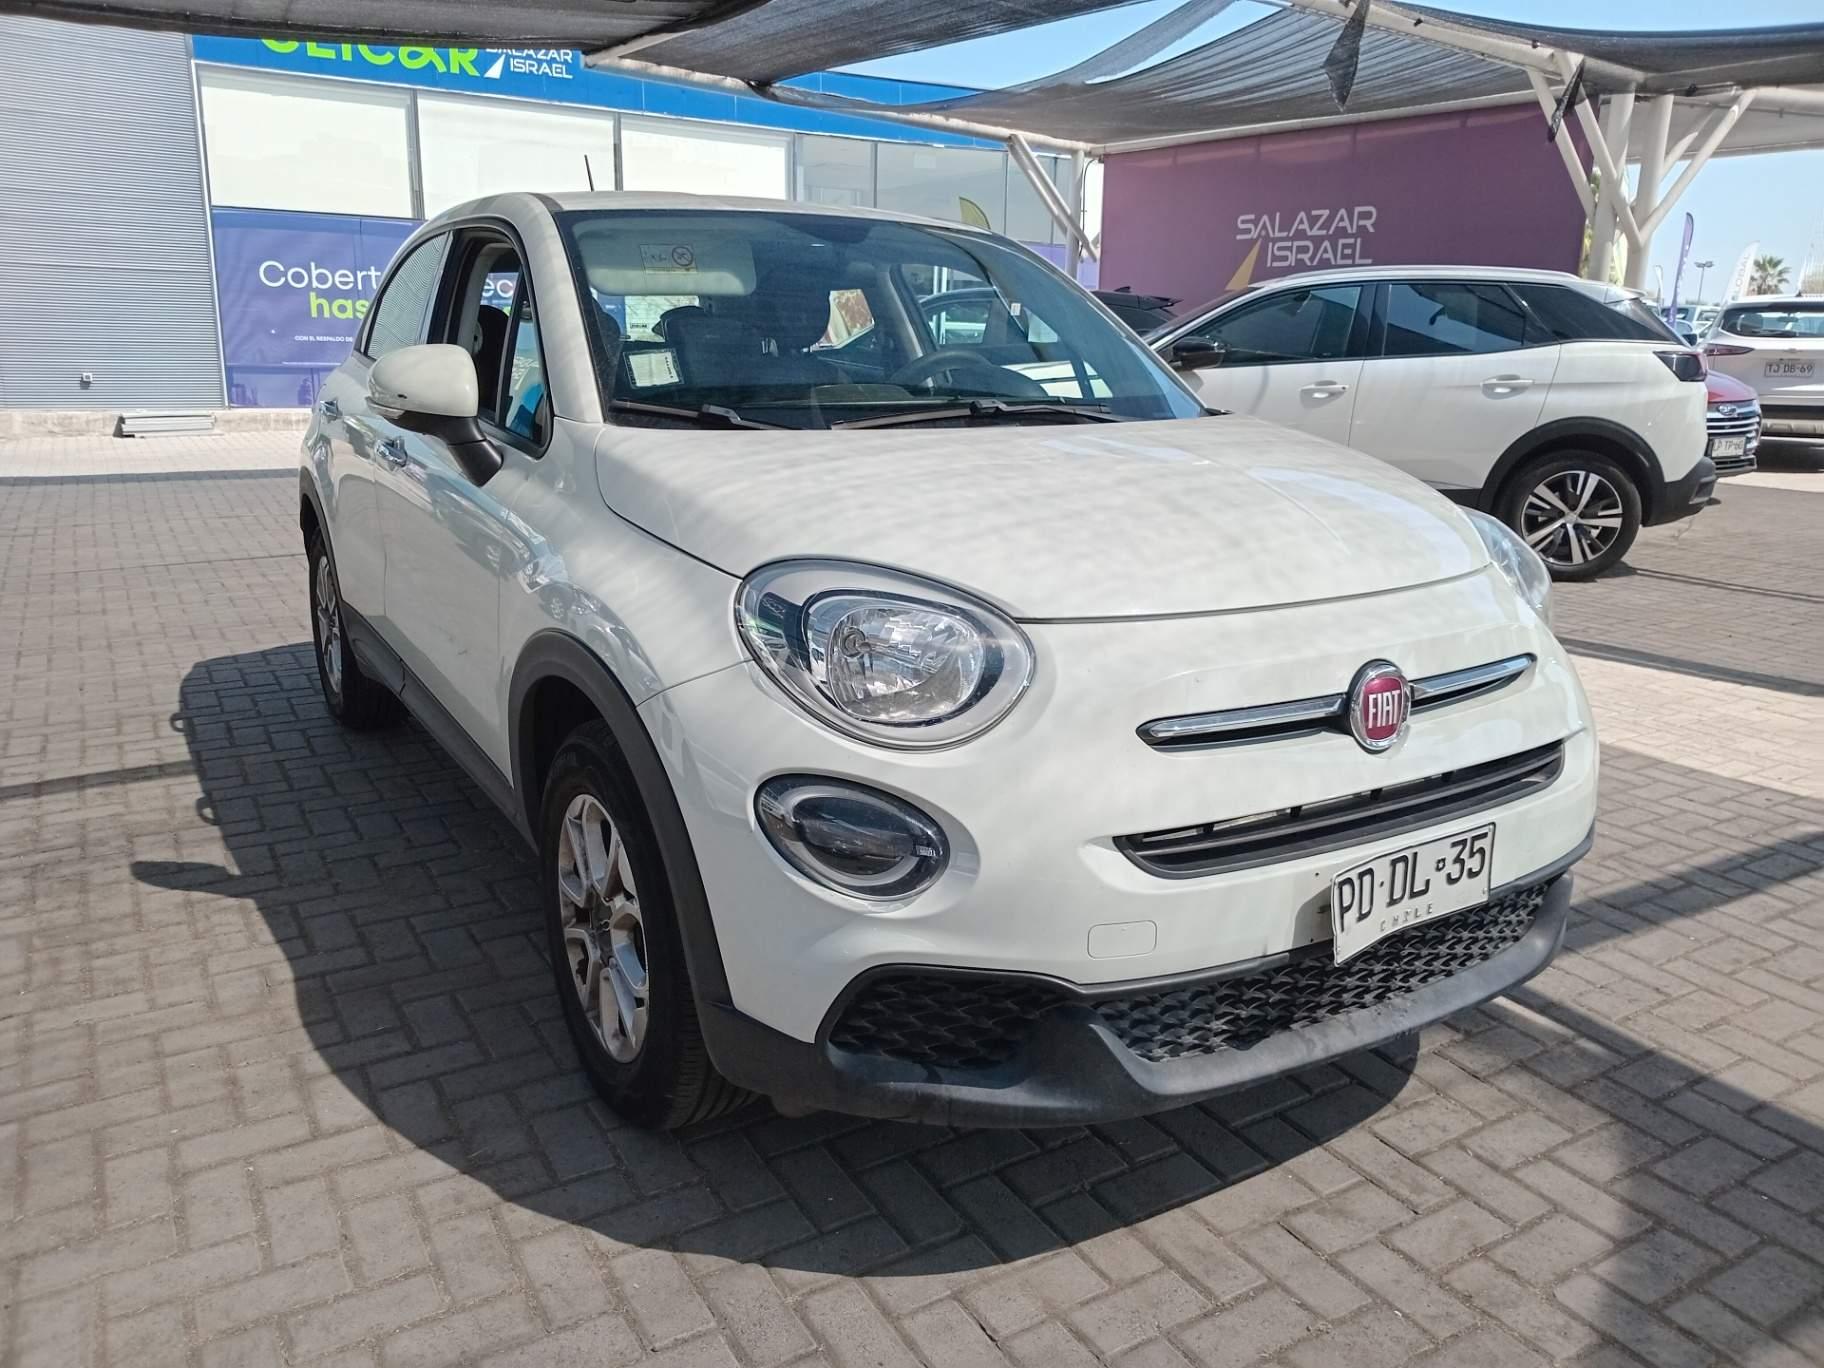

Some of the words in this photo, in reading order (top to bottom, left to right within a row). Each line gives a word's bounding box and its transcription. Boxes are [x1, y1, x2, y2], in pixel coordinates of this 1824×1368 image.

[510, 58, 573, 79] ISRAEL
[1236, 205, 1377, 240] SALAZAR
[1266, 237, 1373, 267] ISRAEL
[1368, 689, 1400, 729] FIAT
[1379, 902, 1434, 932] CHILE
